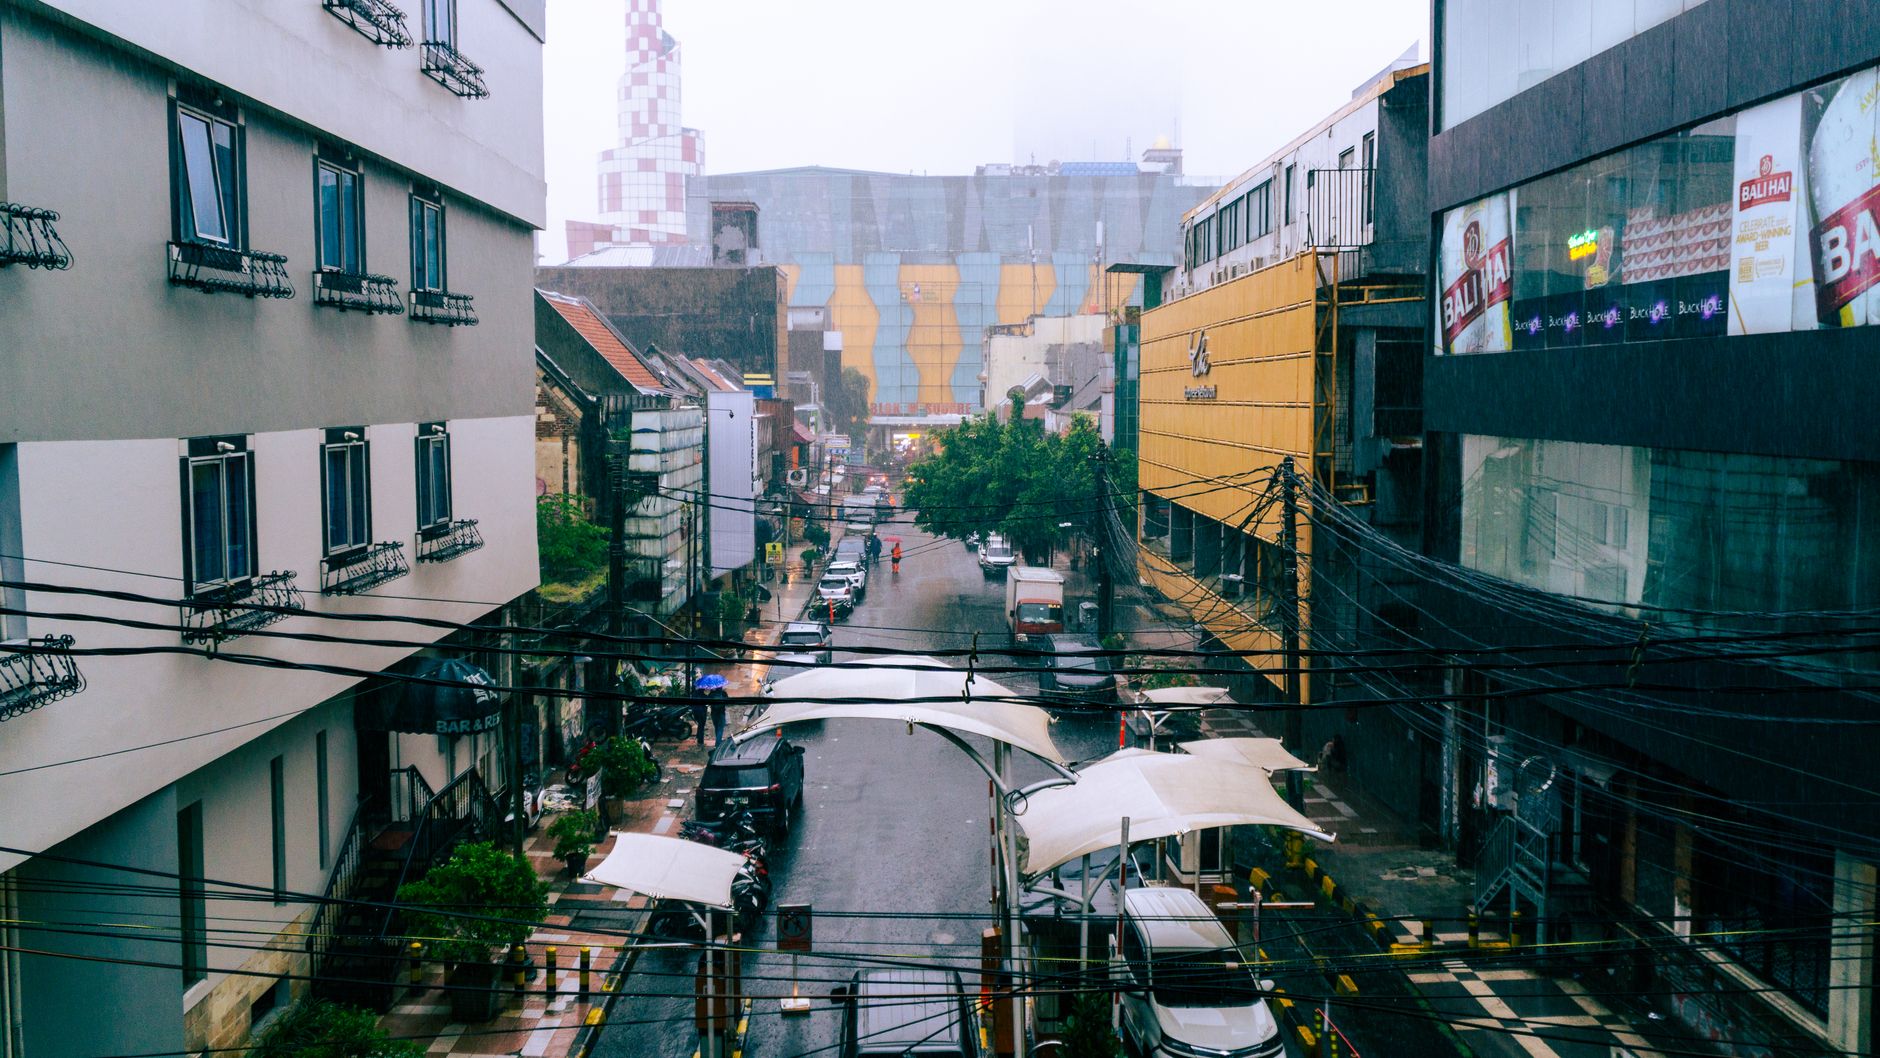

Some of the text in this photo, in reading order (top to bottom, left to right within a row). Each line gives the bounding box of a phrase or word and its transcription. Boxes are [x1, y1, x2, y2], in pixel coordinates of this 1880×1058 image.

[1742, 175, 1790, 202] BALI HAI
[1740, 215, 1775, 233] CELEBRATE
[1755, 240, 1769, 252] BEER
[1443, 243, 1511, 330] BALI HAI
[436, 720, 470, 733] BAR
[473, 719, 482, 731] &
